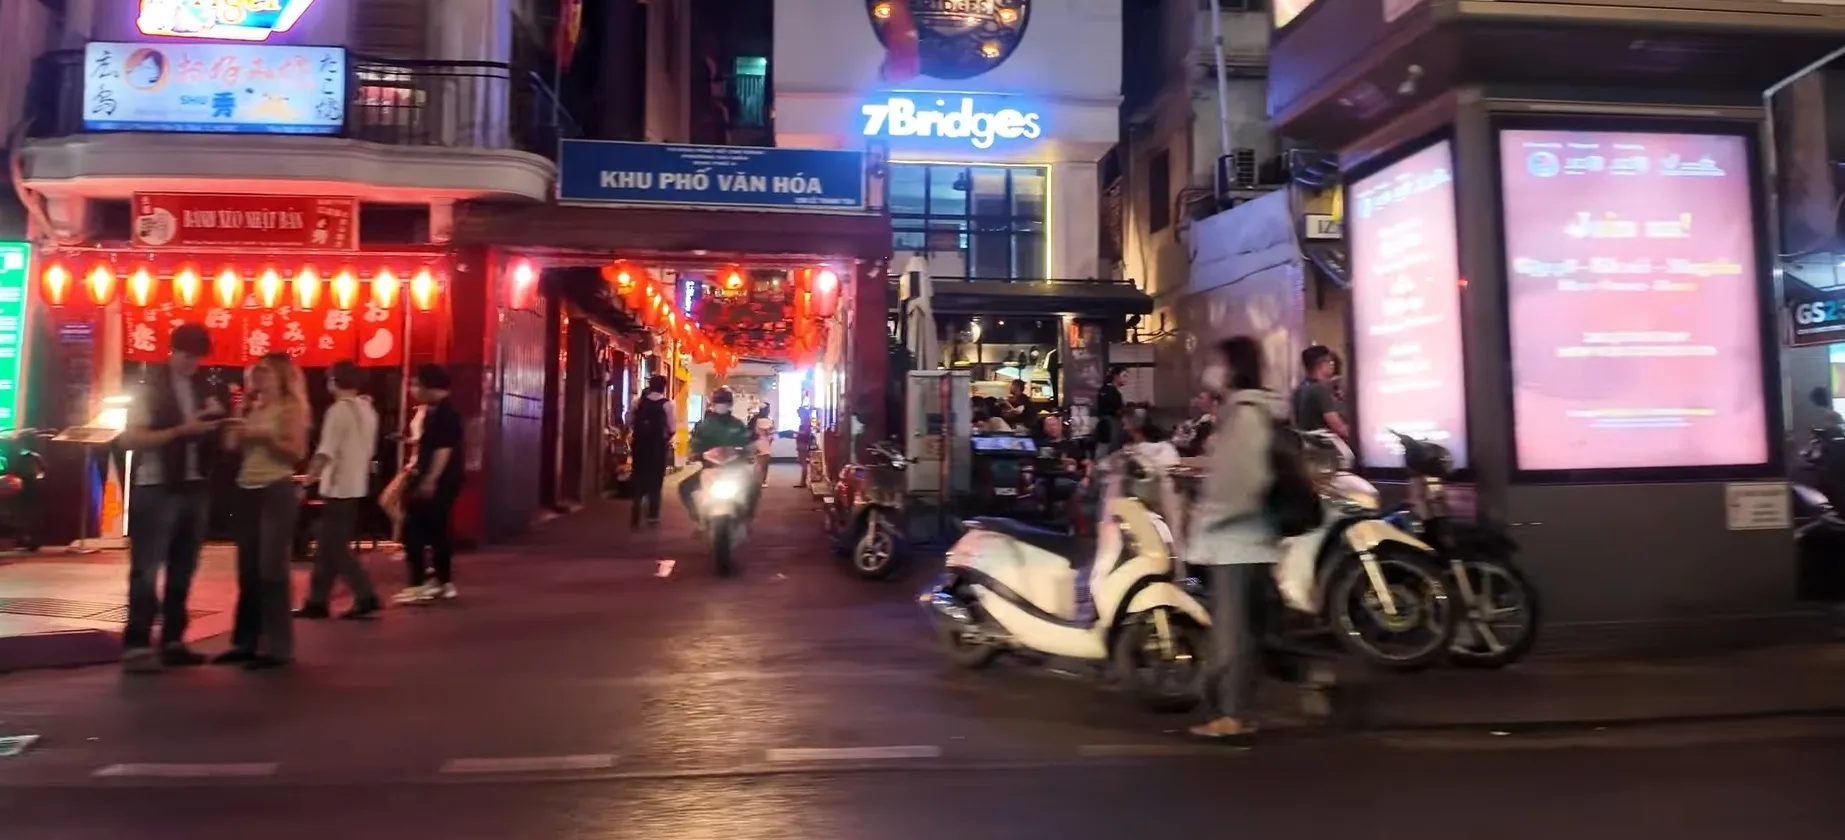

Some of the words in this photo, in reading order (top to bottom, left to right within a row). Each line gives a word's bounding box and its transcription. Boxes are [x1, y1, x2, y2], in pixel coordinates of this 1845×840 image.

[862, 97, 1041, 149] 7Bridges
[600, 170, 653, 190] KHU
[659, 166, 711, 191] PHỐ
[717, 171, 767, 193] VĂN
[772, 172, 823, 195] HÓA
